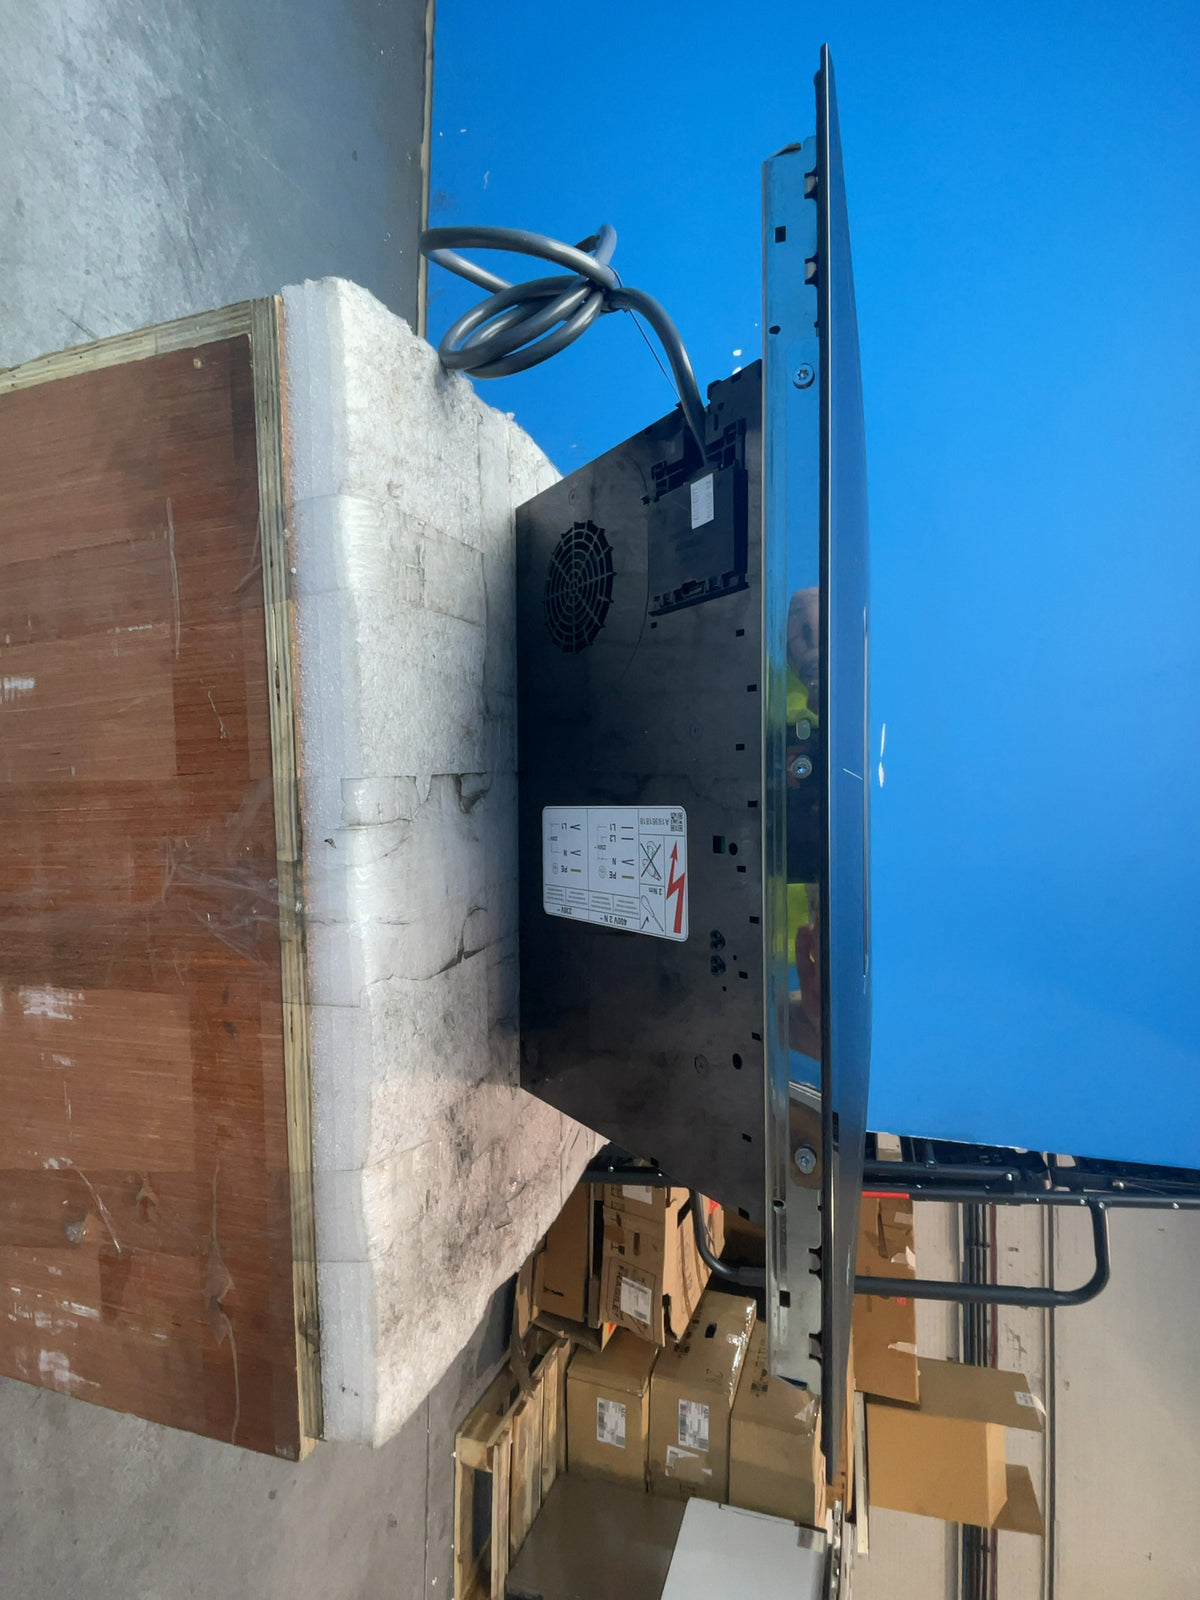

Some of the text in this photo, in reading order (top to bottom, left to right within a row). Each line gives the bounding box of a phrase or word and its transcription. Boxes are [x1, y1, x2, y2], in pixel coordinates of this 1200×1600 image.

[609, 823, 616, 831] L1
[609, 834, 616, 843] L2
[560, 865, 568, 873] PE
[609, 871, 617, 880] PE
[614, 917, 627, 926] 400V
